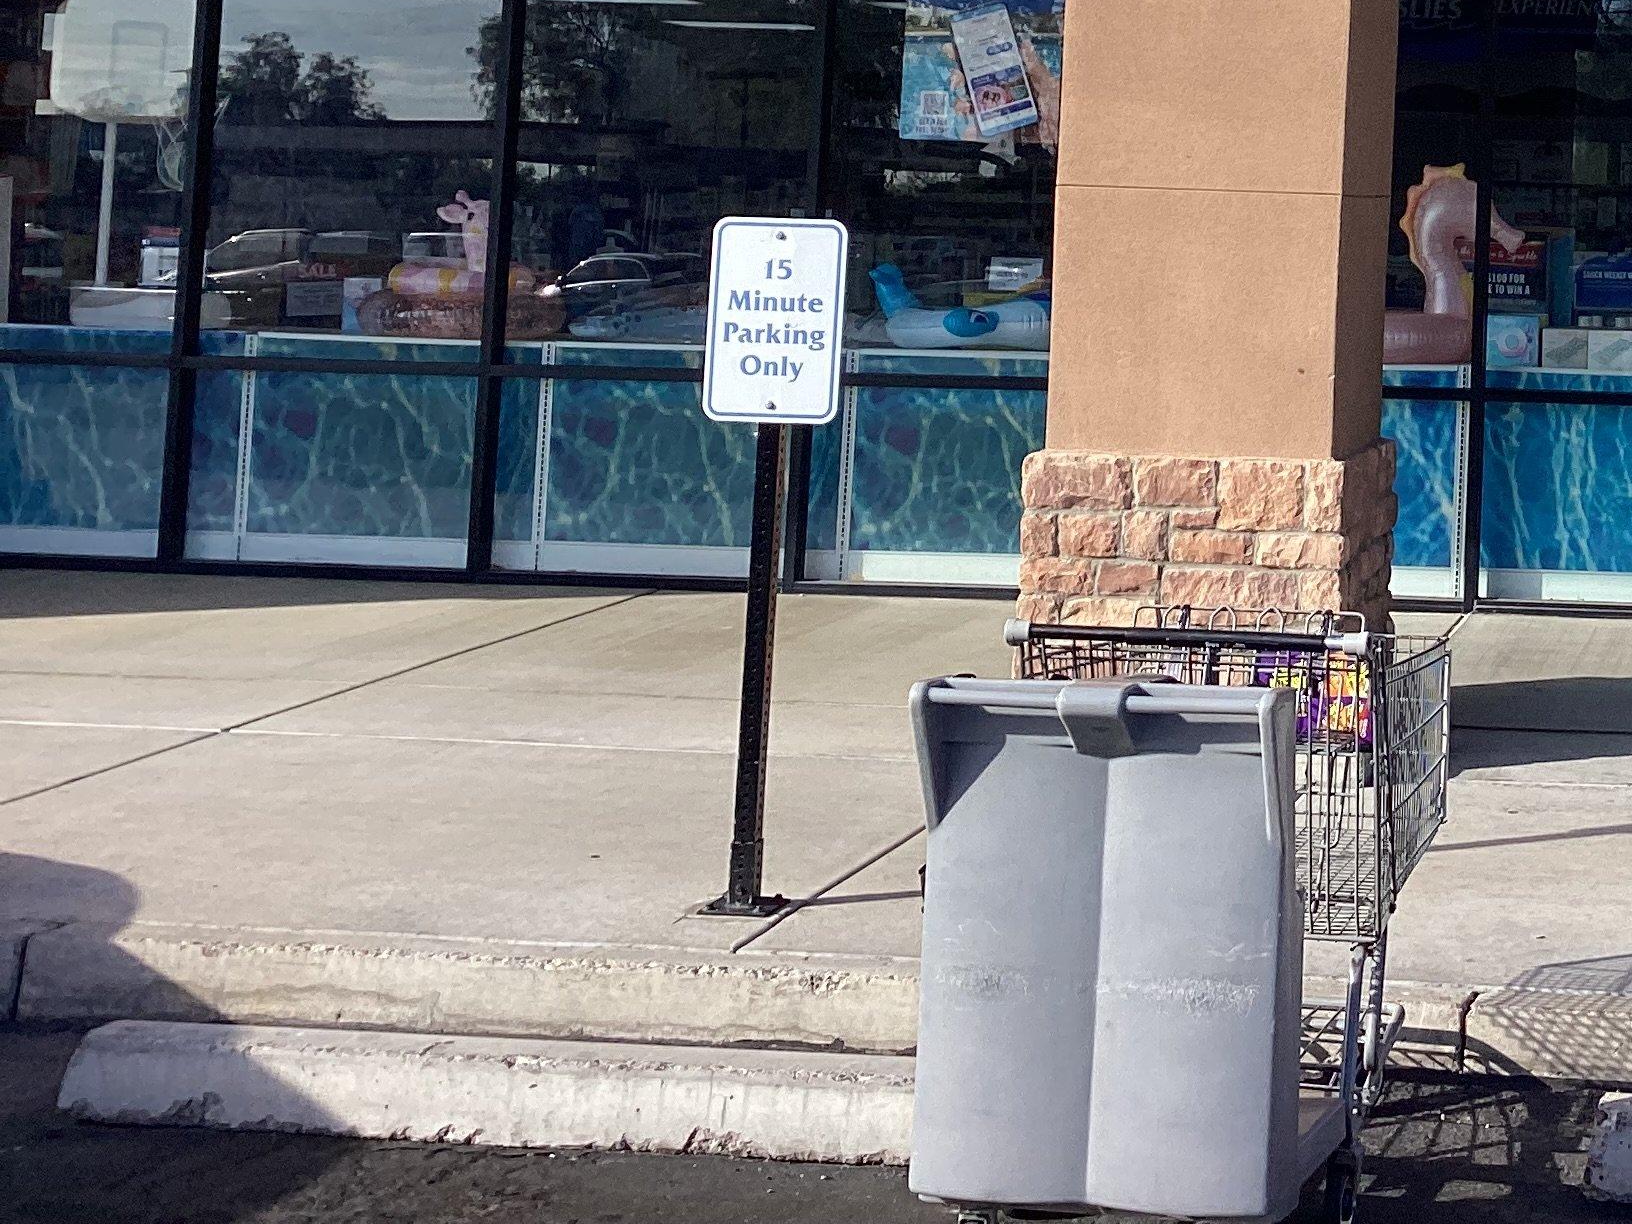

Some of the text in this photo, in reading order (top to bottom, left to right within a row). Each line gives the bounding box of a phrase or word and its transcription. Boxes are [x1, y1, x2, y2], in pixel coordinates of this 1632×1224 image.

[765, 258, 793, 280] 15
[1508, 273, 1525, 284] FOR
[728, 290, 823, 313] Minute
[723, 321, 826, 351] Parking
[740, 354, 804, 383] Only
